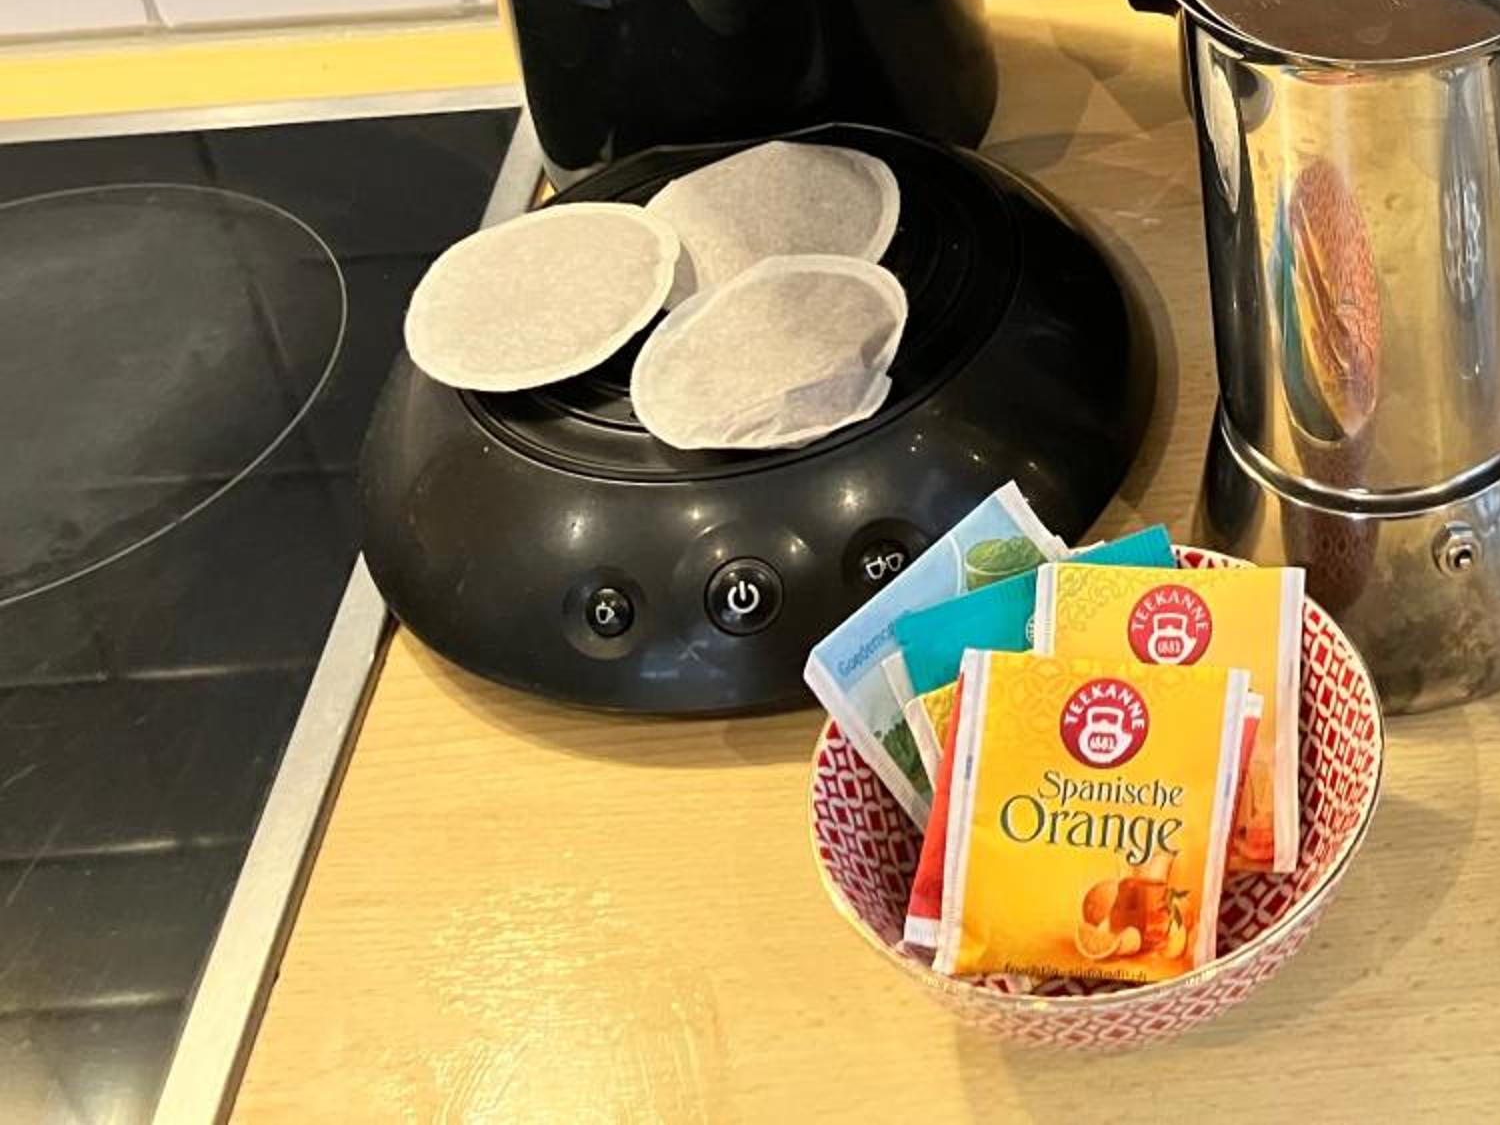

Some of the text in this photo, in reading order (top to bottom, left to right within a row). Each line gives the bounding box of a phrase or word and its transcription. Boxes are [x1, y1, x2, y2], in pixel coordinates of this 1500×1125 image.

[1130, 589, 1209, 632] TEEKANNE
[1064, 683, 1145, 731] TEEKANNE
[1037, 769, 1184, 811] Spanische
[1000, 794, 1183, 867] Orange
